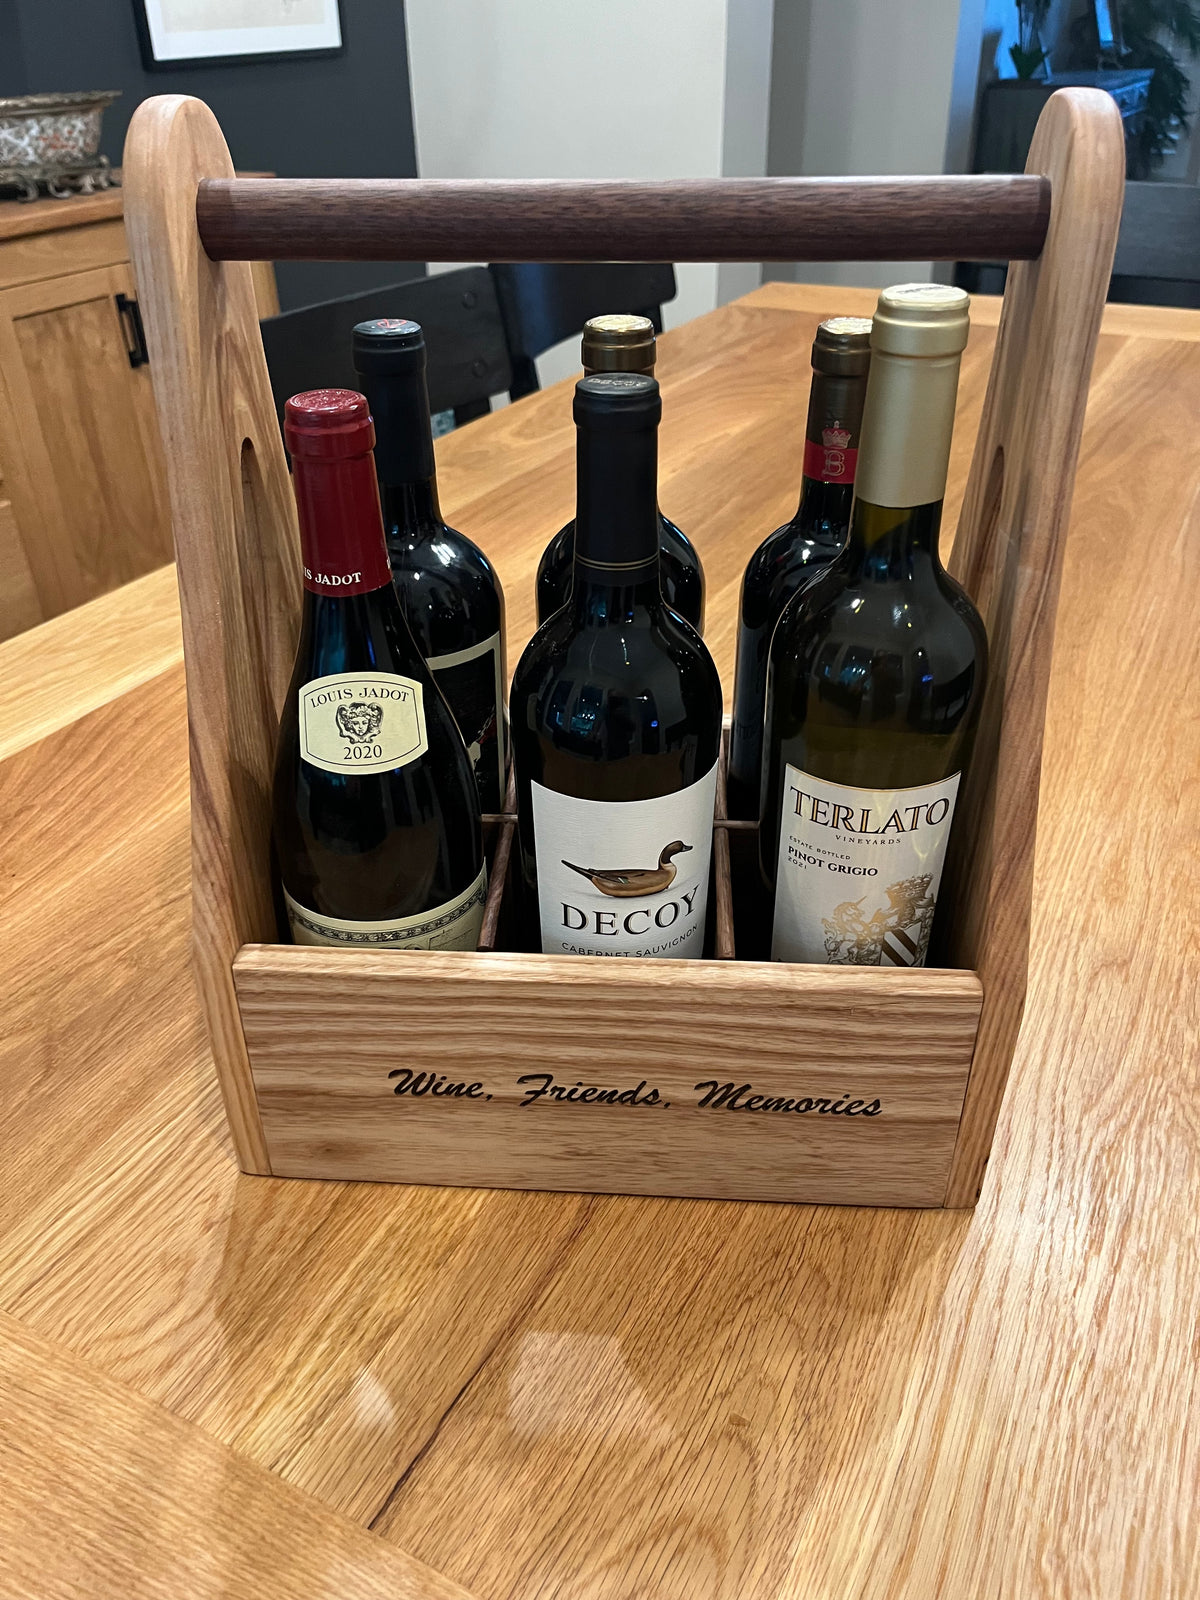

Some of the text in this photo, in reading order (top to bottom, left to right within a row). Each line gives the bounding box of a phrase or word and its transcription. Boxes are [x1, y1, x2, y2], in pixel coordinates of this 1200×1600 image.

[822, 450, 845, 476] B
[315, 572, 361, 586] JADOT
[310, 687, 409, 708] LOUIS JADOT
[344, 745, 382, 760] 2020
[790, 786, 950, 835] TERLATO
[789, 835, 851, 860] ESTATE BOTTLED
[835, 835, 901, 845] VINEYARDS
[787, 856, 807, 869] 2021
[788, 845, 878, 877] PINOT GRIGIO
[560, 884, 700, 936] DECOY
[635, 924, 698, 957] SAUVIGNON
[388, 1068, 493, 1101] Wine,
[694, 1080, 882, 1116] Memories
